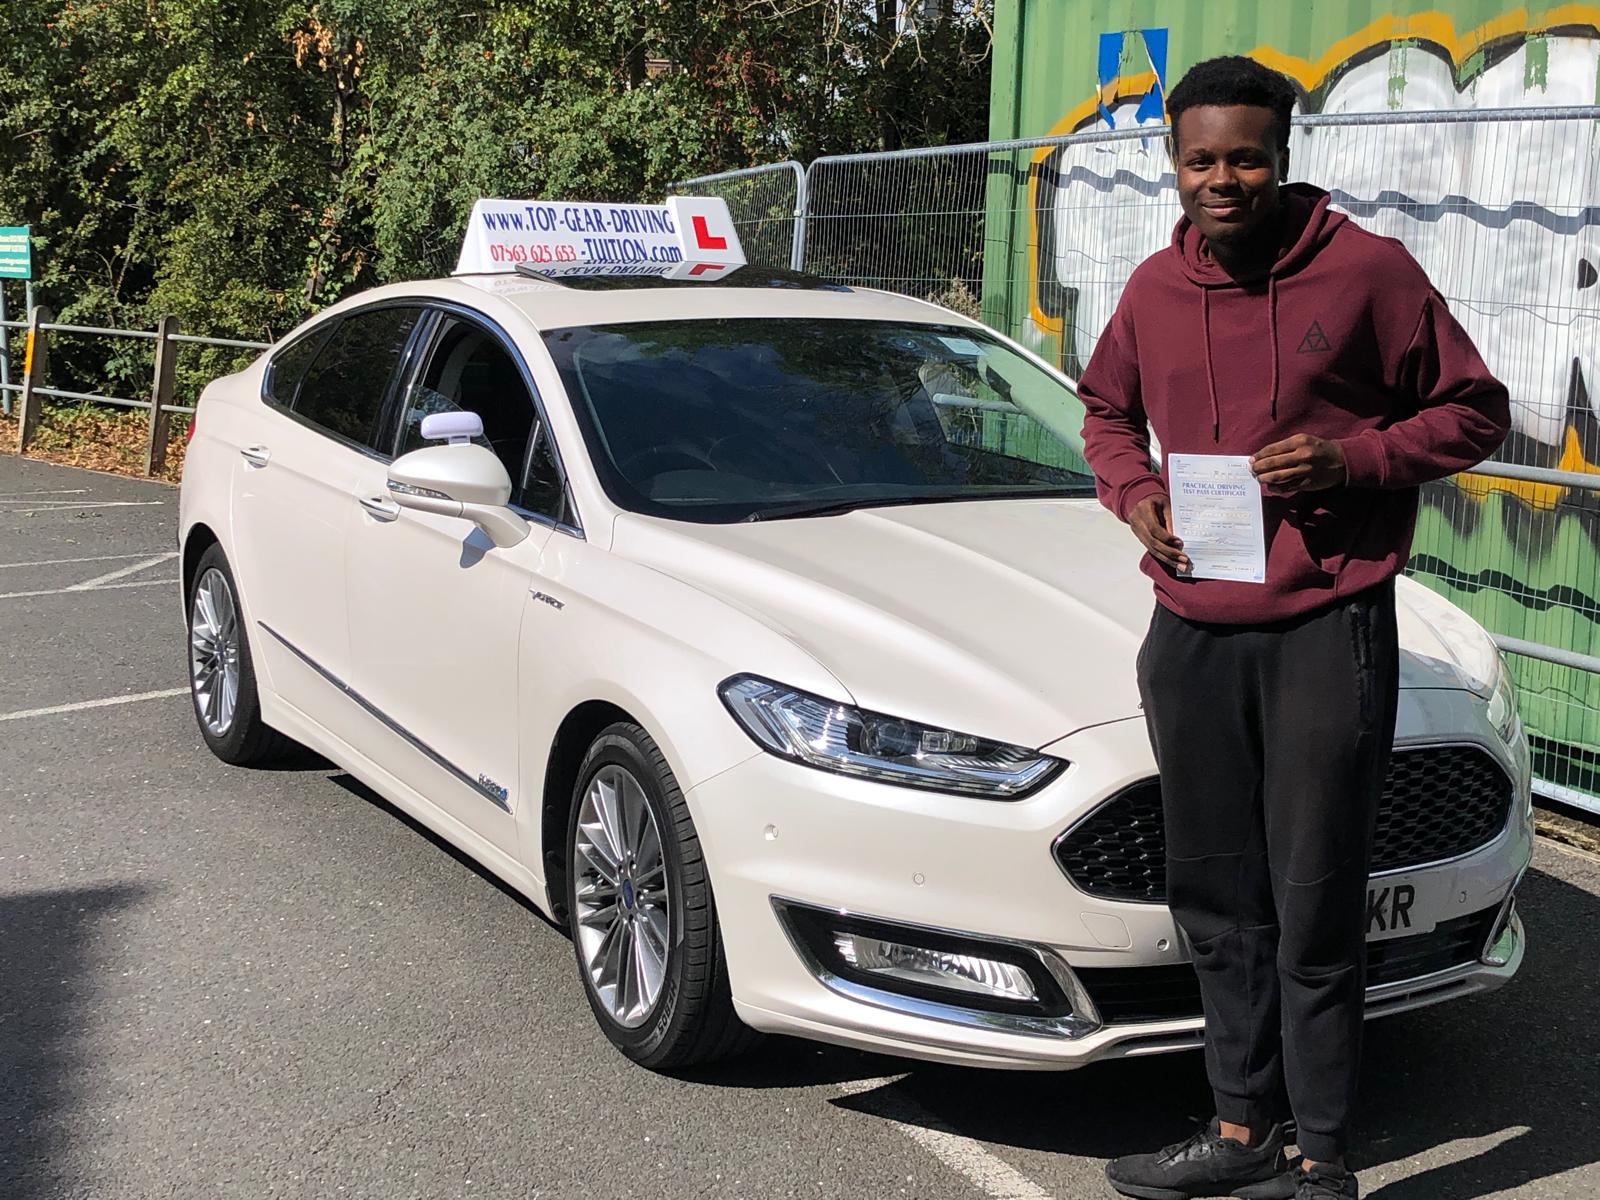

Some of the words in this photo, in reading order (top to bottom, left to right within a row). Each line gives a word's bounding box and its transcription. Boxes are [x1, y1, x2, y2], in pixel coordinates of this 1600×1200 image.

[482, 206, 676, 234] www.TOP-GEAR-DRIVING
[691, 215, 728, 250] L
[530, 245, 552, 263] 625
[555, 245, 577, 262] 653
[1182, 482, 1215, 490] PRACTICAL
[1217, 483, 1246, 491] DRIVING
